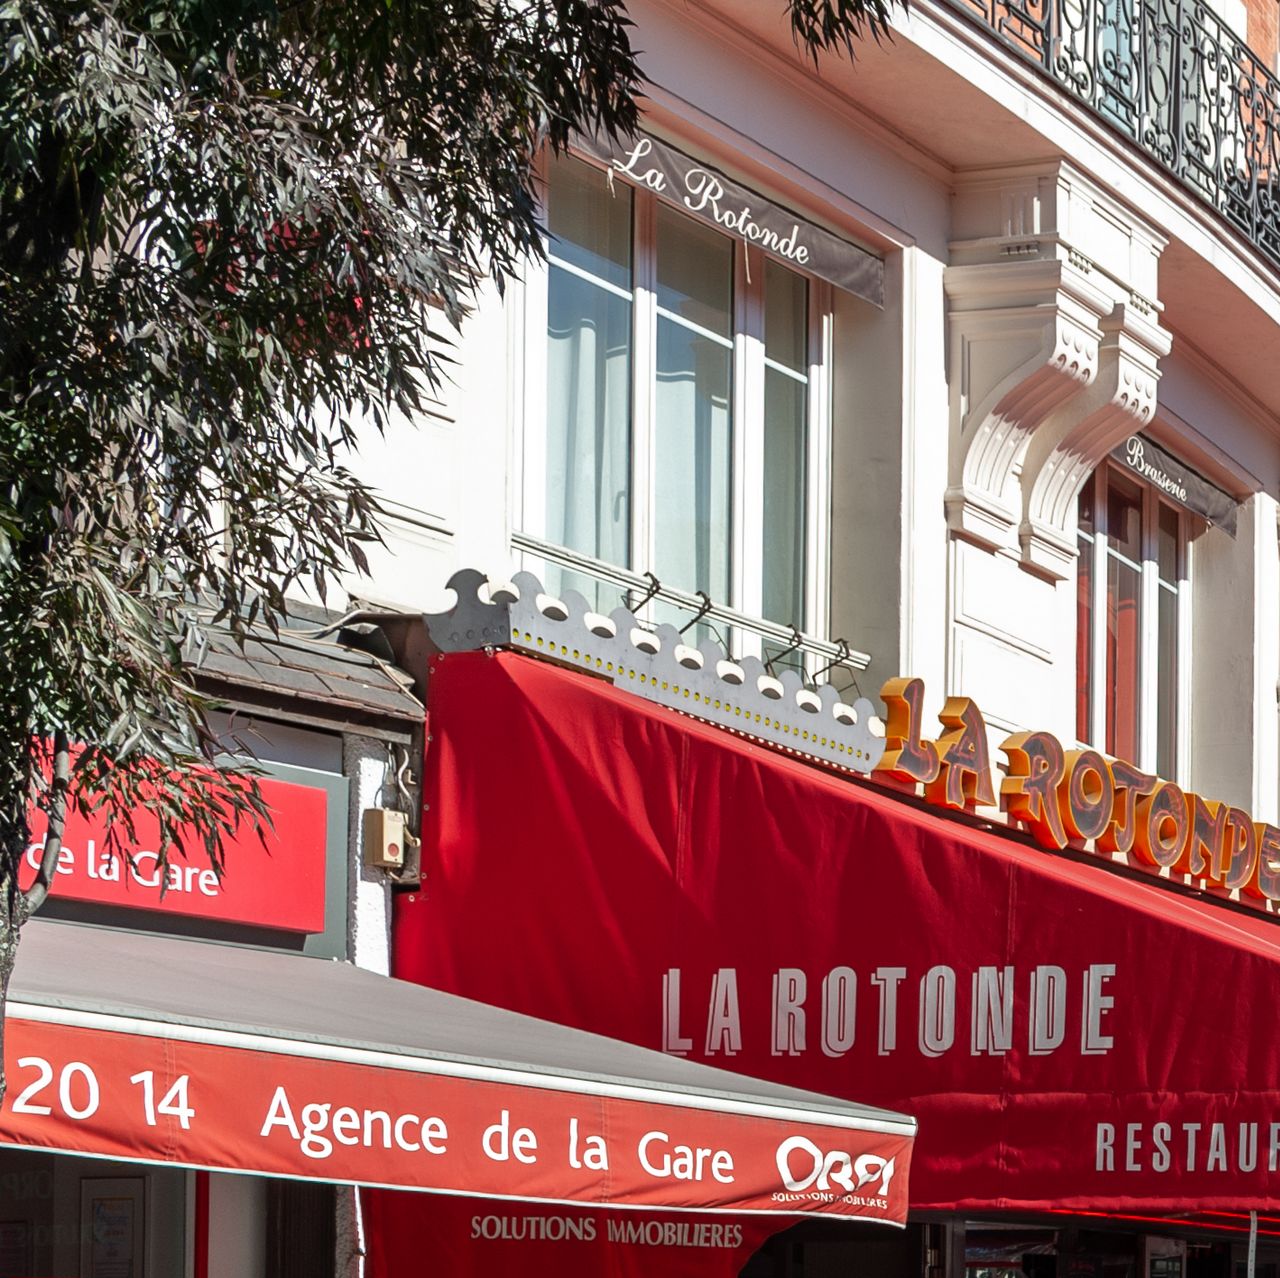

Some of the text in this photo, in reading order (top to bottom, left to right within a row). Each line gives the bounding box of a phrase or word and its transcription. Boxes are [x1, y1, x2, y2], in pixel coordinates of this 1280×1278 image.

[611, 138, 810, 265] La Rotonde
[1126, 435, 1188, 502] Brasserie
[876, 677, 997, 810] LA
[25, 832, 220, 897] de la Gare
[661, 963, 1117, 1059] LA ROTONDE
[12, 1055, 896, 1197] 20 14 Agence de la Gare ORPI
[470, 1214, 744, 1249] SOLUTIONS IMMOBILIERES
